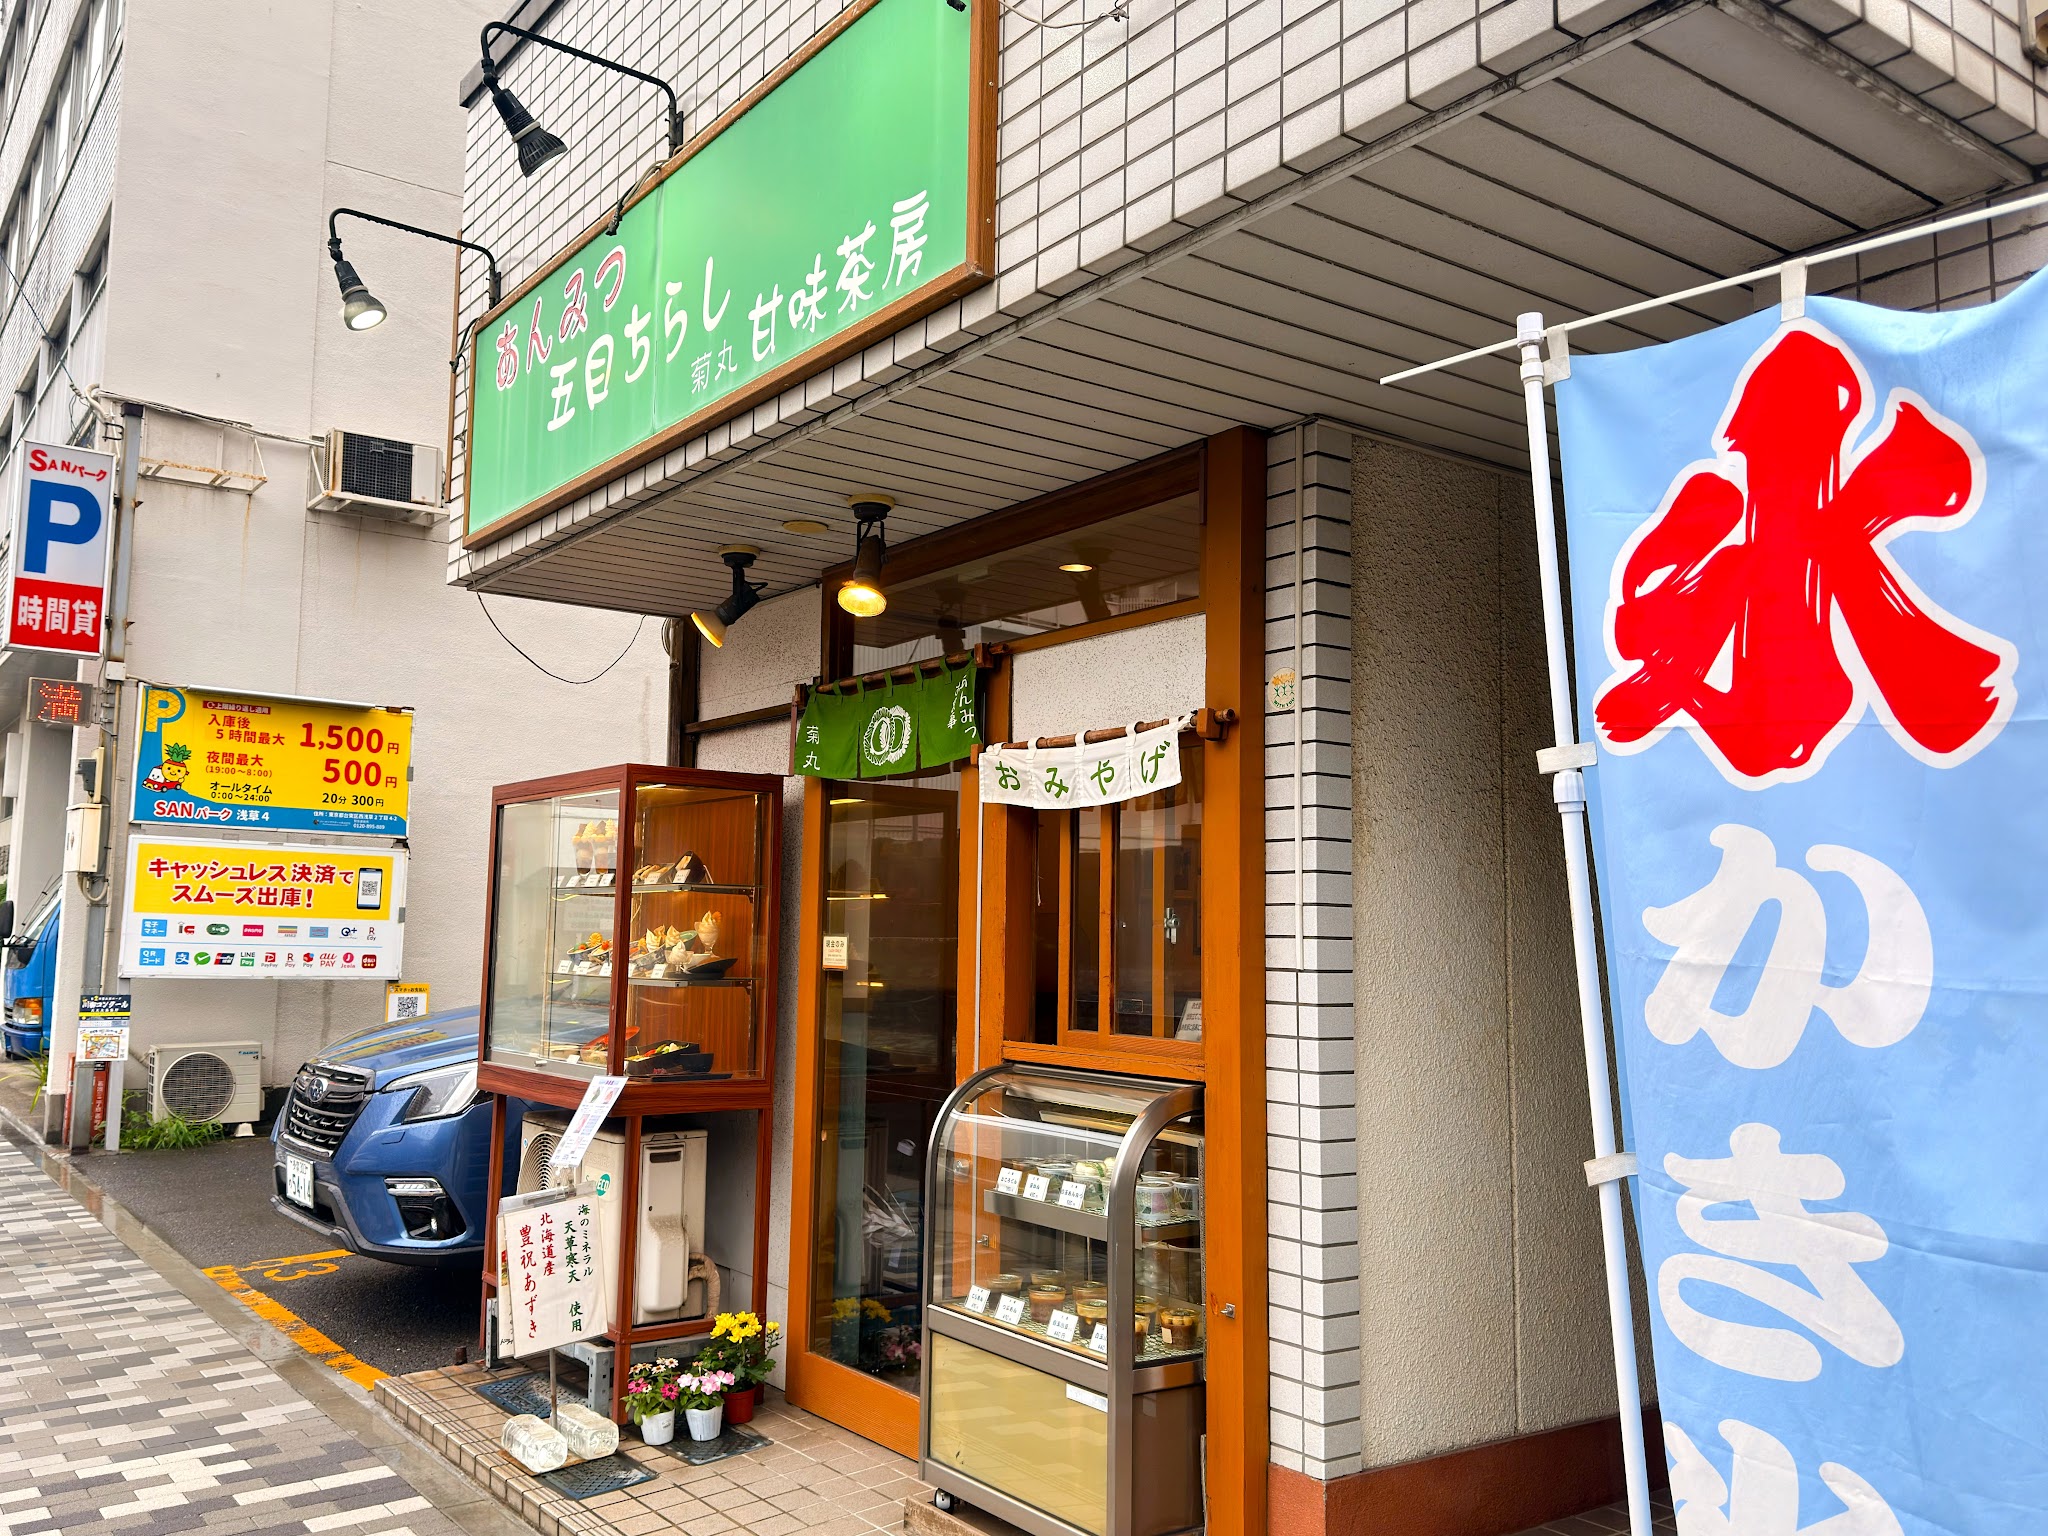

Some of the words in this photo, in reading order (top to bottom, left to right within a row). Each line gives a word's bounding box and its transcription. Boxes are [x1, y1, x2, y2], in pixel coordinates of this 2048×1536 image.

[748, 189, 930, 363] 甘味茶房
[496, 245, 627, 392] あんみつ
[547, 255, 731, 432] 五目ちらし
[690, 339, 738, 395] 菊丸
[28, 449, 107, 482] SANパーク
[23, 479, 101, 574] P
[1594, 322, 2016, 788] 氷
[17, 595, 97, 637] 時間貸
[208, 714, 250, 729] 入庫後
[207, 751, 263, 767] 夜間最大
[323, 758, 397, 788] 500円
[802, 725, 821, 771] 菊丸
[995, 740, 1171, 799] おみやげ
[154, 801, 232, 821] SANパーク
[210, 781, 273, 795] オールタイム
[144, 920, 158, 929] 電子
[320, 960, 336, 968] PAY
[540, 1212, 557, 1277] 北海道産
[563, 1220, 582, 1284] 天草寒天
[578, 1203, 594, 1278] 海のミネラル
[519, 1224, 538, 1339] 豊祝あずき
[569, 1300, 584, 1333] 使用
